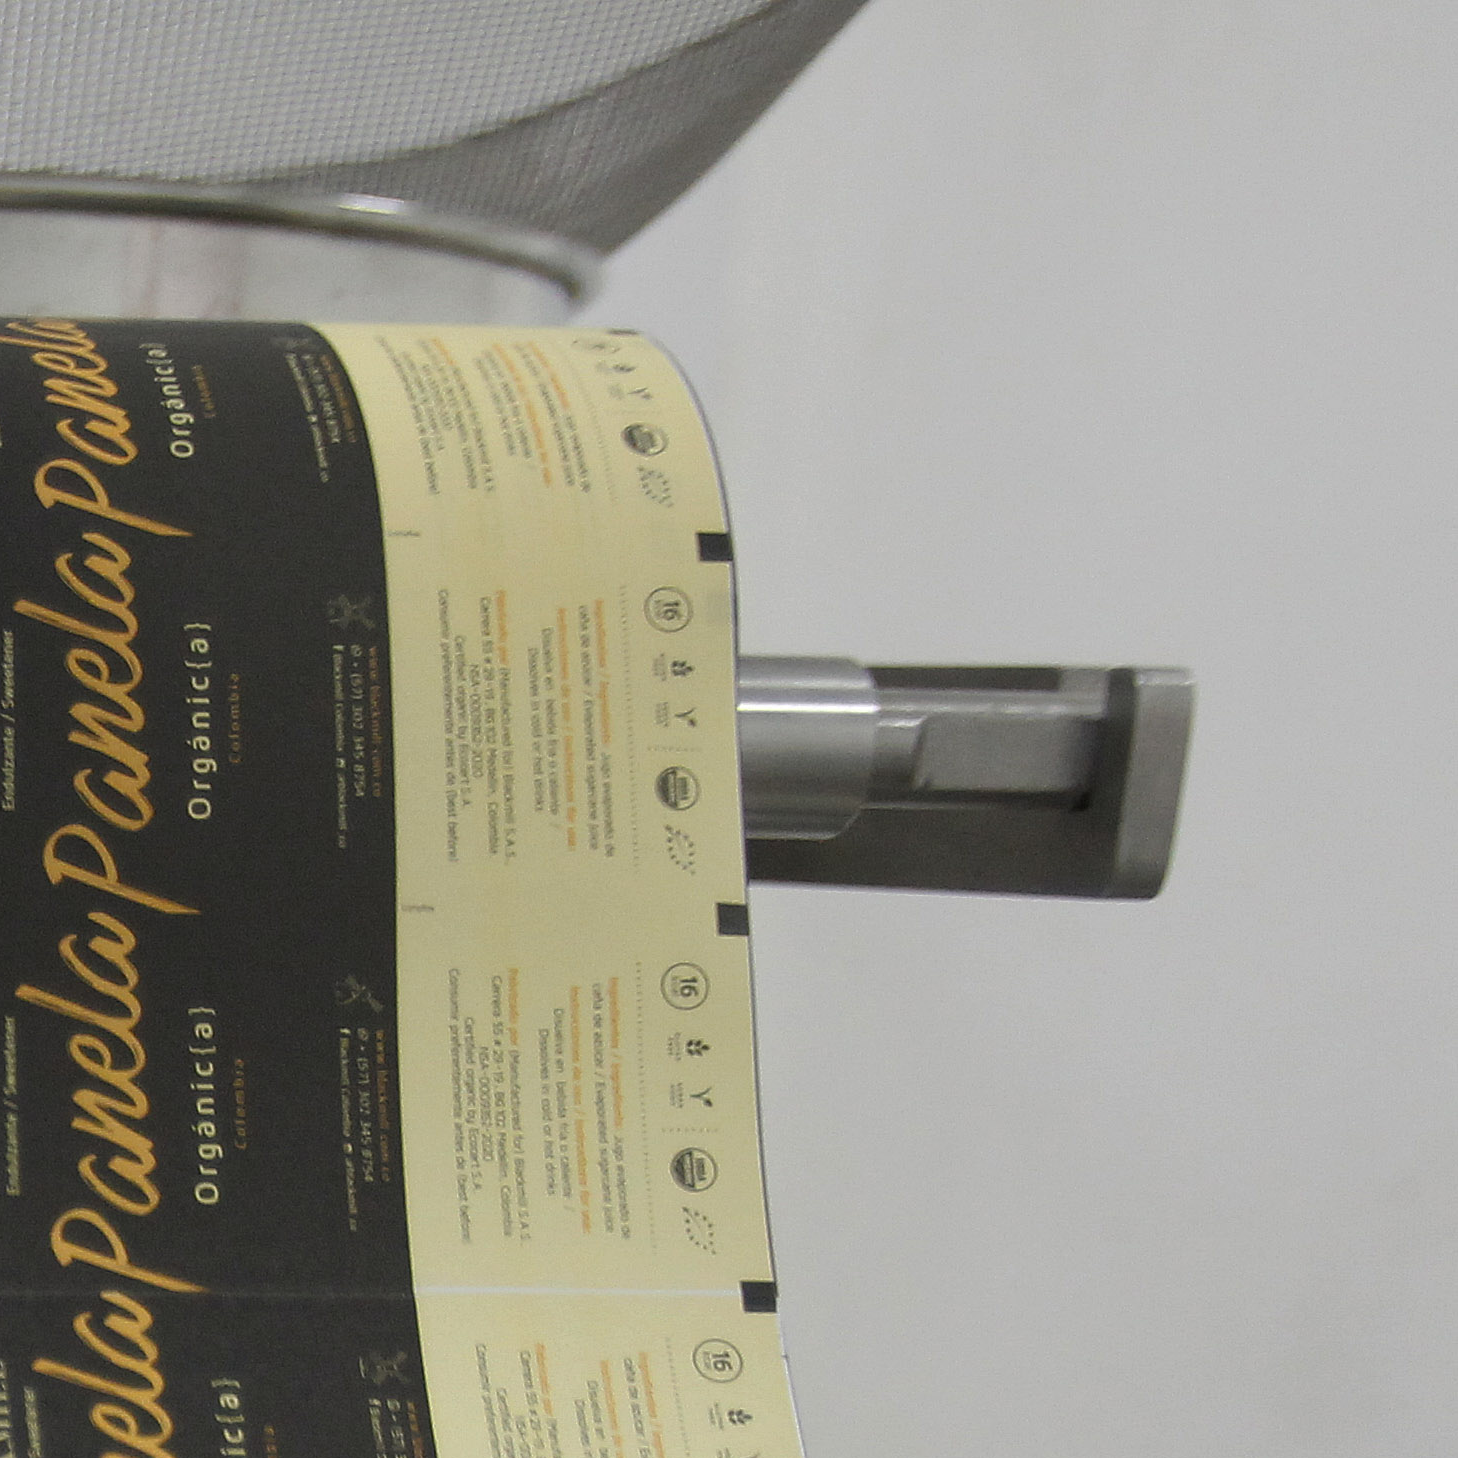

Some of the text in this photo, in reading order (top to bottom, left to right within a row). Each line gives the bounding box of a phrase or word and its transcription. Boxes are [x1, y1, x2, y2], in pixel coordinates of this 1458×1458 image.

[664, 600, 682, 621] 16
[0, 630, 15, 708] Sweetener
[13, 533, 201, 915] Panela
[227, 673, 241, 764] Colombia
[351, 704, 364, 730] 302
[352, 736, 364, 760] 345
[0, 728, 16, 811] Endulzante
[353, 764, 365, 798] 8754
[680, 976, 699, 998] 16
[15, 913, 209, 1294] Panela
[232, 1058, 247, 1149] Colombia
[358, 1089, 372, 1114] 302
[491, 976, 504, 1018] Carrera
[500, 1185, 514, 1237] Colombia
[540, 1098, 554, 1122] cold
[360, 1120, 372, 1145] 345
[543, 1140, 556, 1159] hot
[711, 1350, 732, 1372] 16
